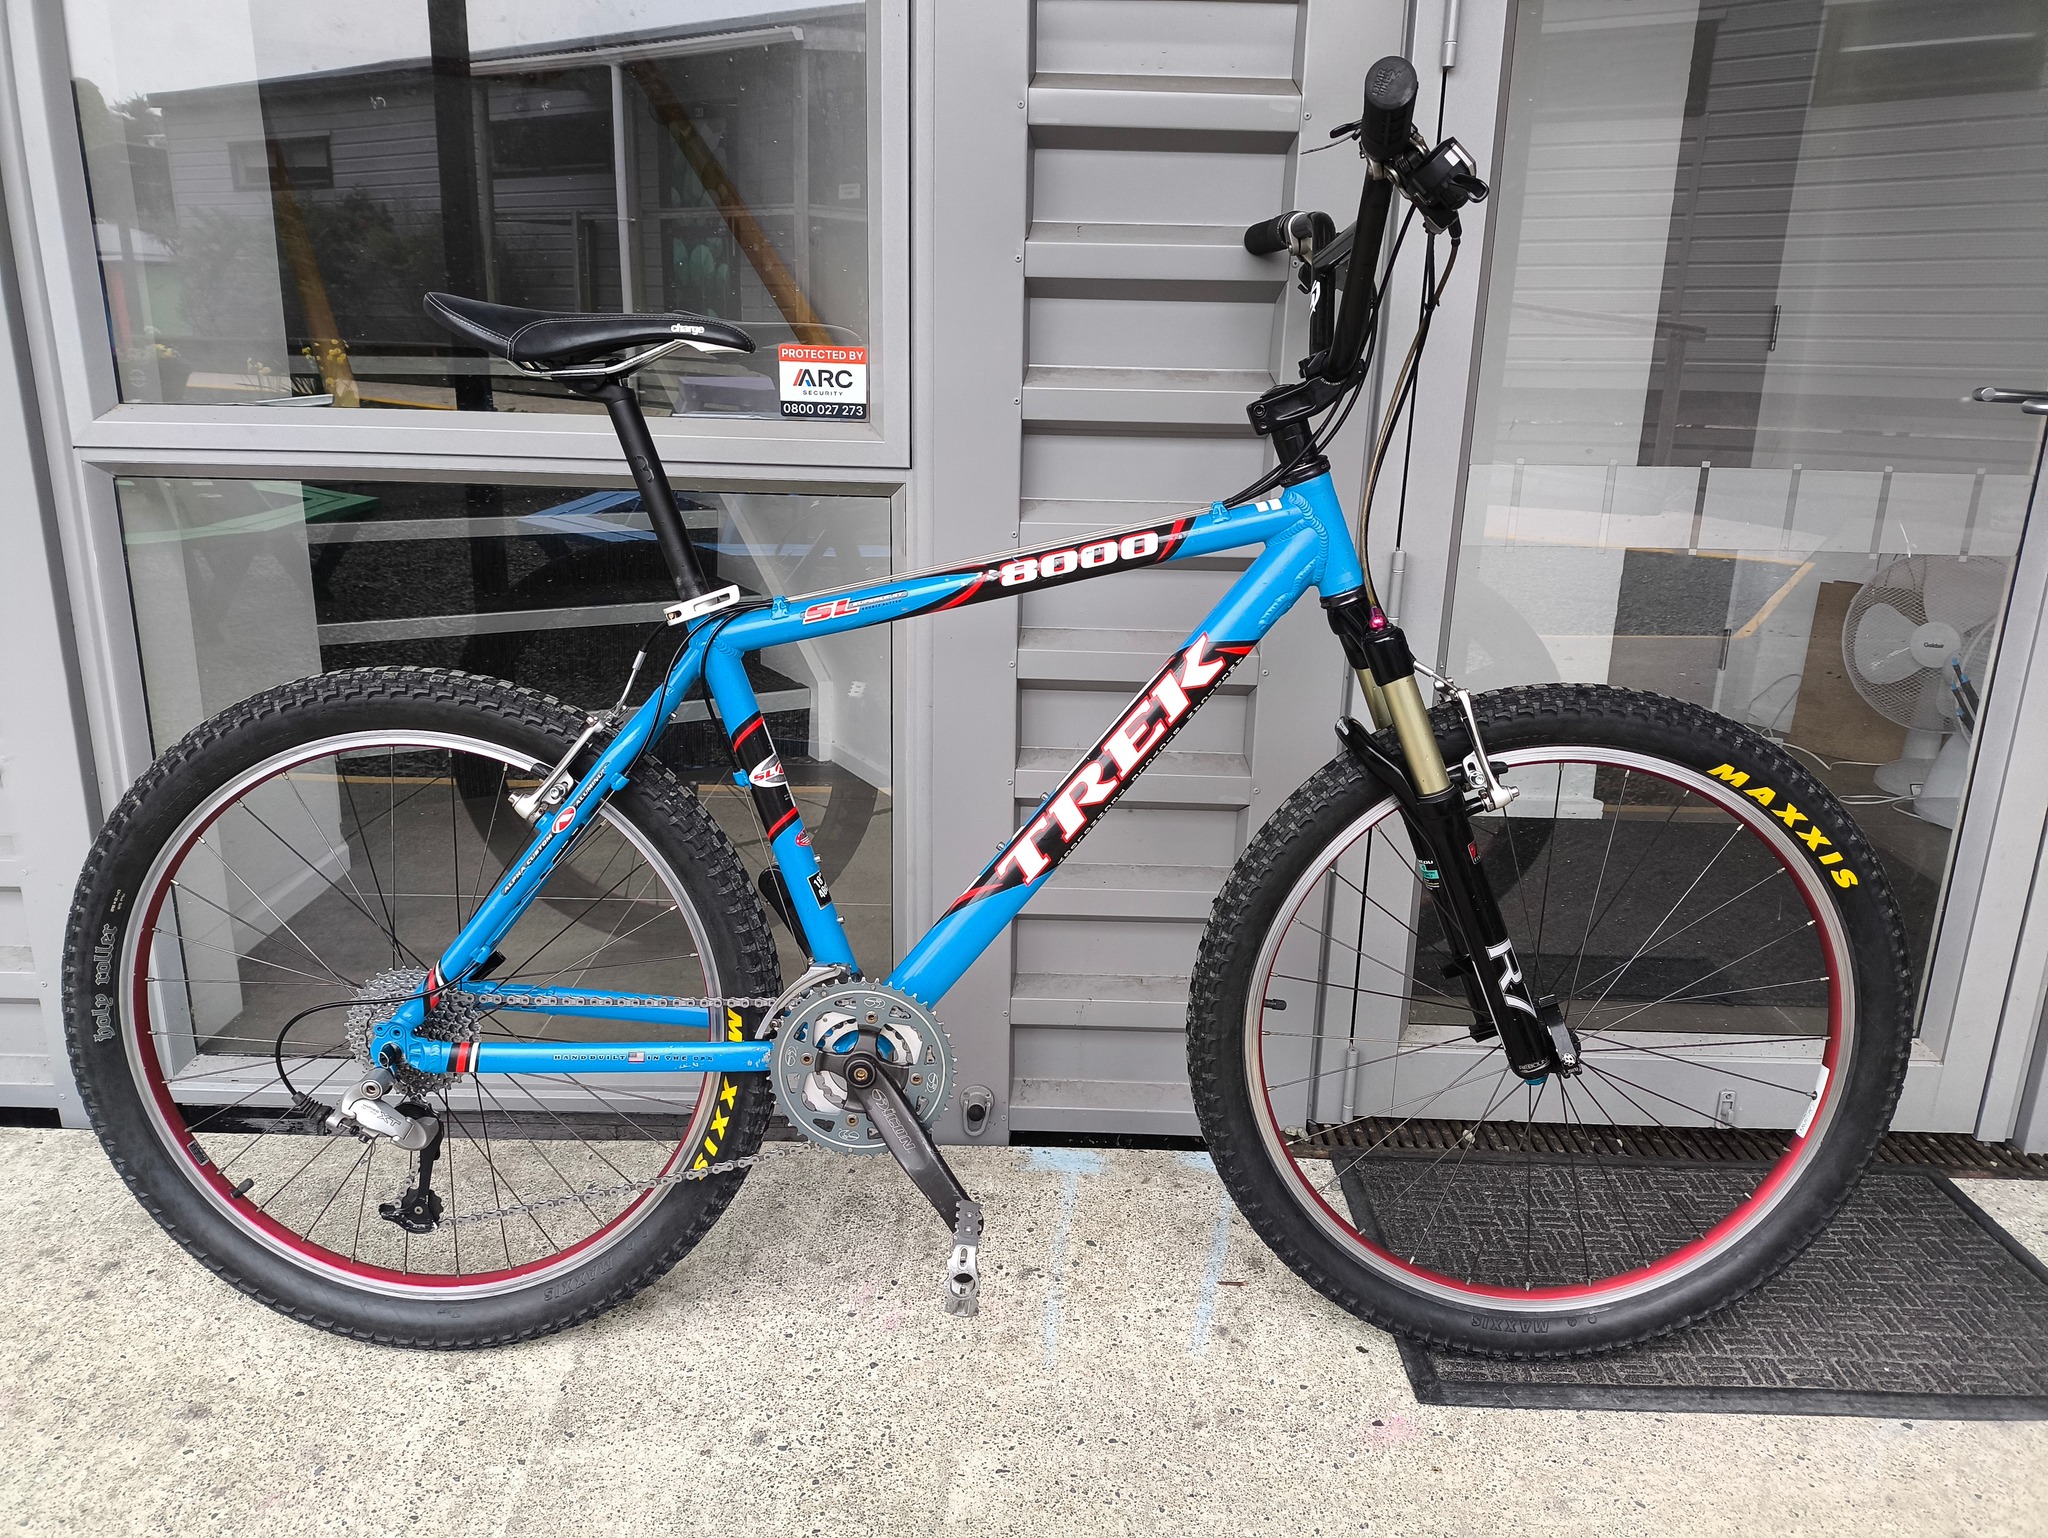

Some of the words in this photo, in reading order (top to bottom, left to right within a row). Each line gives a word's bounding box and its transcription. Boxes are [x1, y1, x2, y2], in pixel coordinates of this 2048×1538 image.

[671, 323, 705, 335] charge
[781, 348, 846, 360] PROTECTED
[849, 351, 864, 360] BY
[793, 368, 853, 389] ARC
[802, 389, 843, 397] SECURITY
[783, 403, 814, 414] 0800
[817, 404, 839, 415] 027
[842, 405, 863, 416] 273
[1000, 530, 1159, 587] 8000
[803, 598, 861, 625] SL
[995, 631, 1226, 887] TREK
[1706, 763, 1859, 888] MAXXIS
[503, 866, 527, 895] ALPHA
[526, 833, 554, 867] CUSTOM
[94, 923, 118, 985] roller
[693, 1007, 743, 1181] MXXIS
[377, 1111, 401, 1127] XT
[1471, 1316, 1549, 1333] MAXXIS
